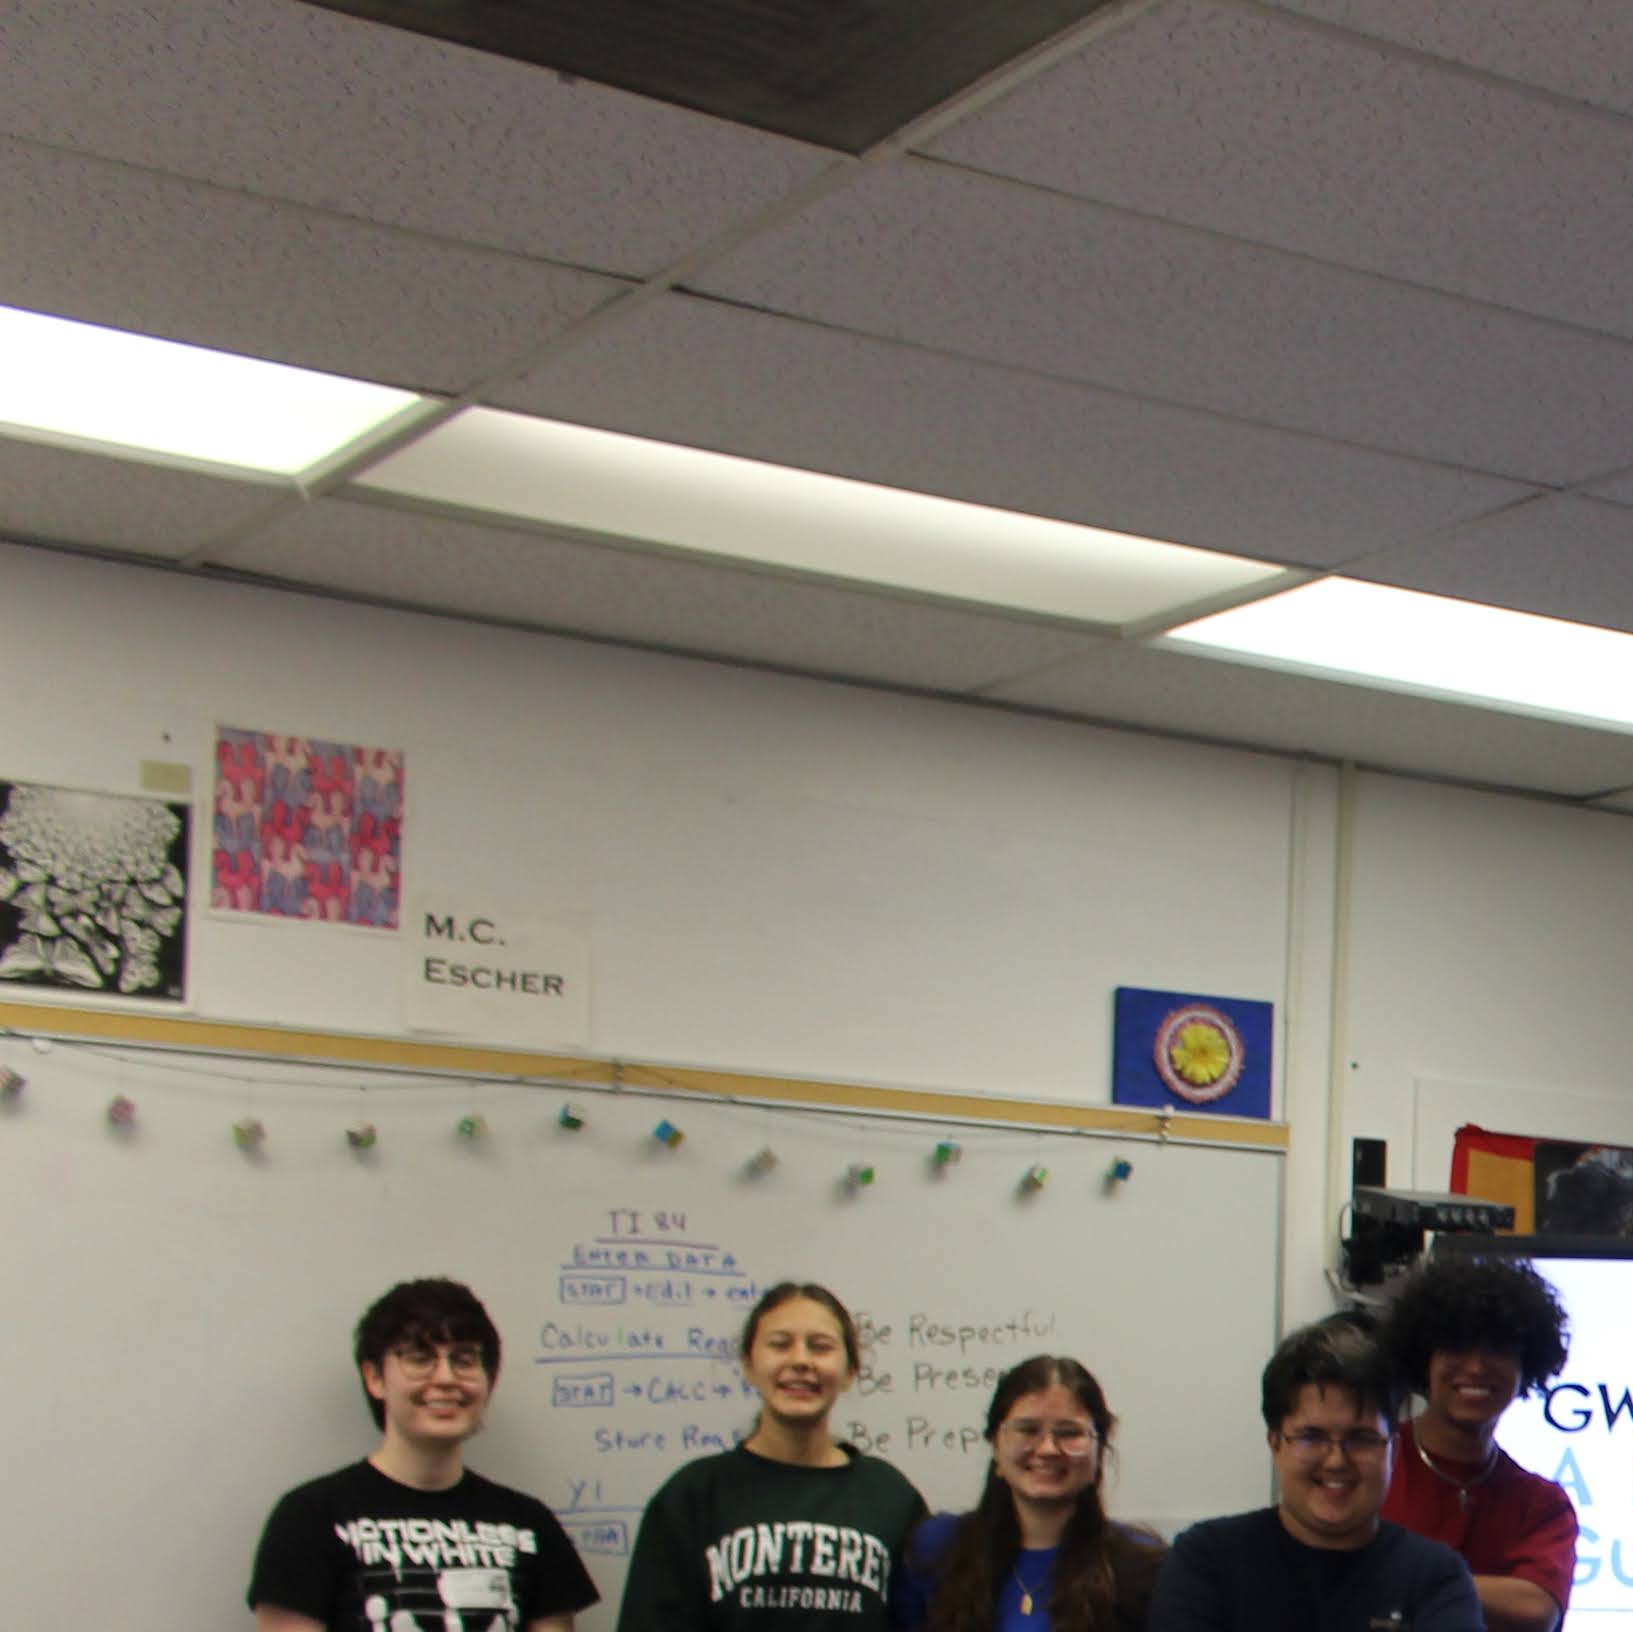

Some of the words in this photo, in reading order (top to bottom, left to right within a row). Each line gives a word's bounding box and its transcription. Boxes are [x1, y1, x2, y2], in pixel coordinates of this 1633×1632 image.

[424, 912, 506, 946] M.C.
[854, 1312, 892, 1346] Be
[909, 1306, 1057, 1352] Respectful
[857, 1364, 893, 1396] Be
[847, 1420, 892, 1453] Be
[1553, 1446, 1593, 1507] A
[400, 1542, 515, 1571] WHITE
[740, 1584, 864, 1614] CALIFORNIA
